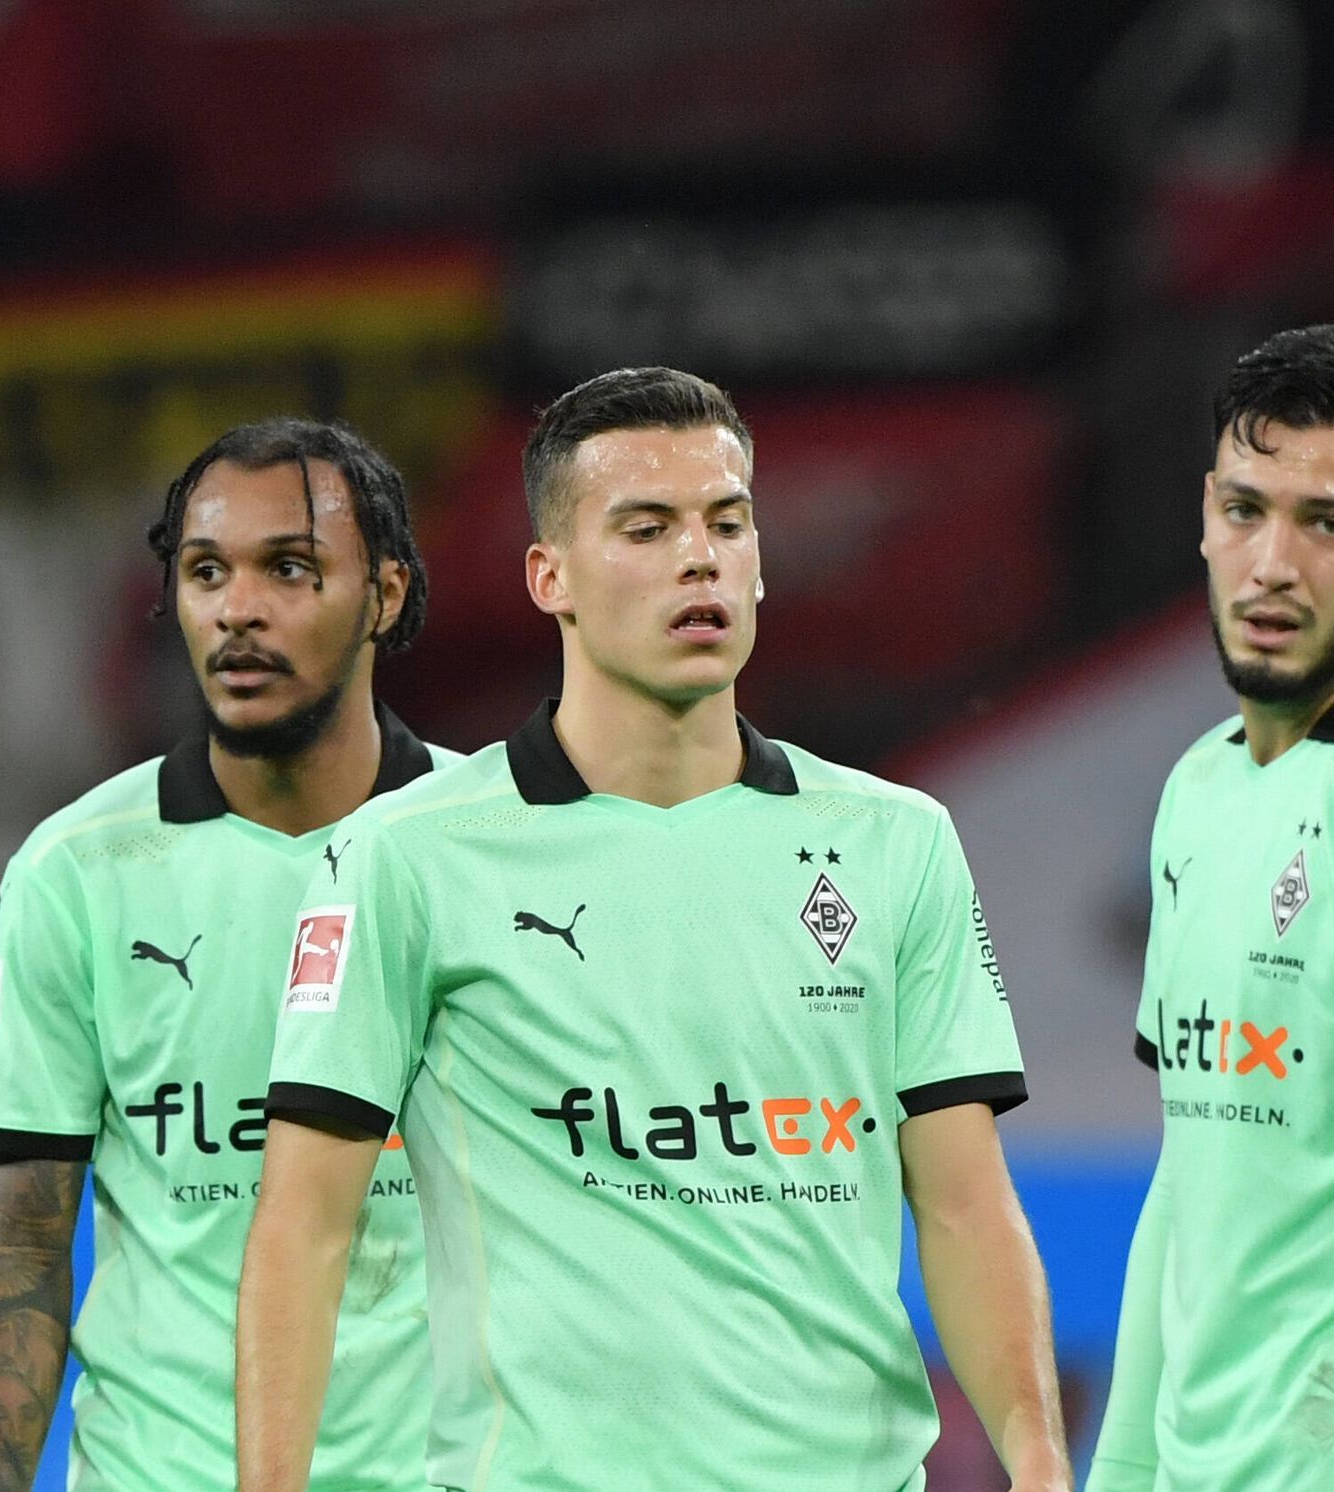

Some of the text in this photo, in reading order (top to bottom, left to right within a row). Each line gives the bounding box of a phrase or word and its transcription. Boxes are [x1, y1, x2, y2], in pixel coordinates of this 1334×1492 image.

[799, 986, 865, 998] 120 JAHRE
[808, 1003, 831, 1012] 1900
[677, 1185, 771, 1205] ONLINE.
